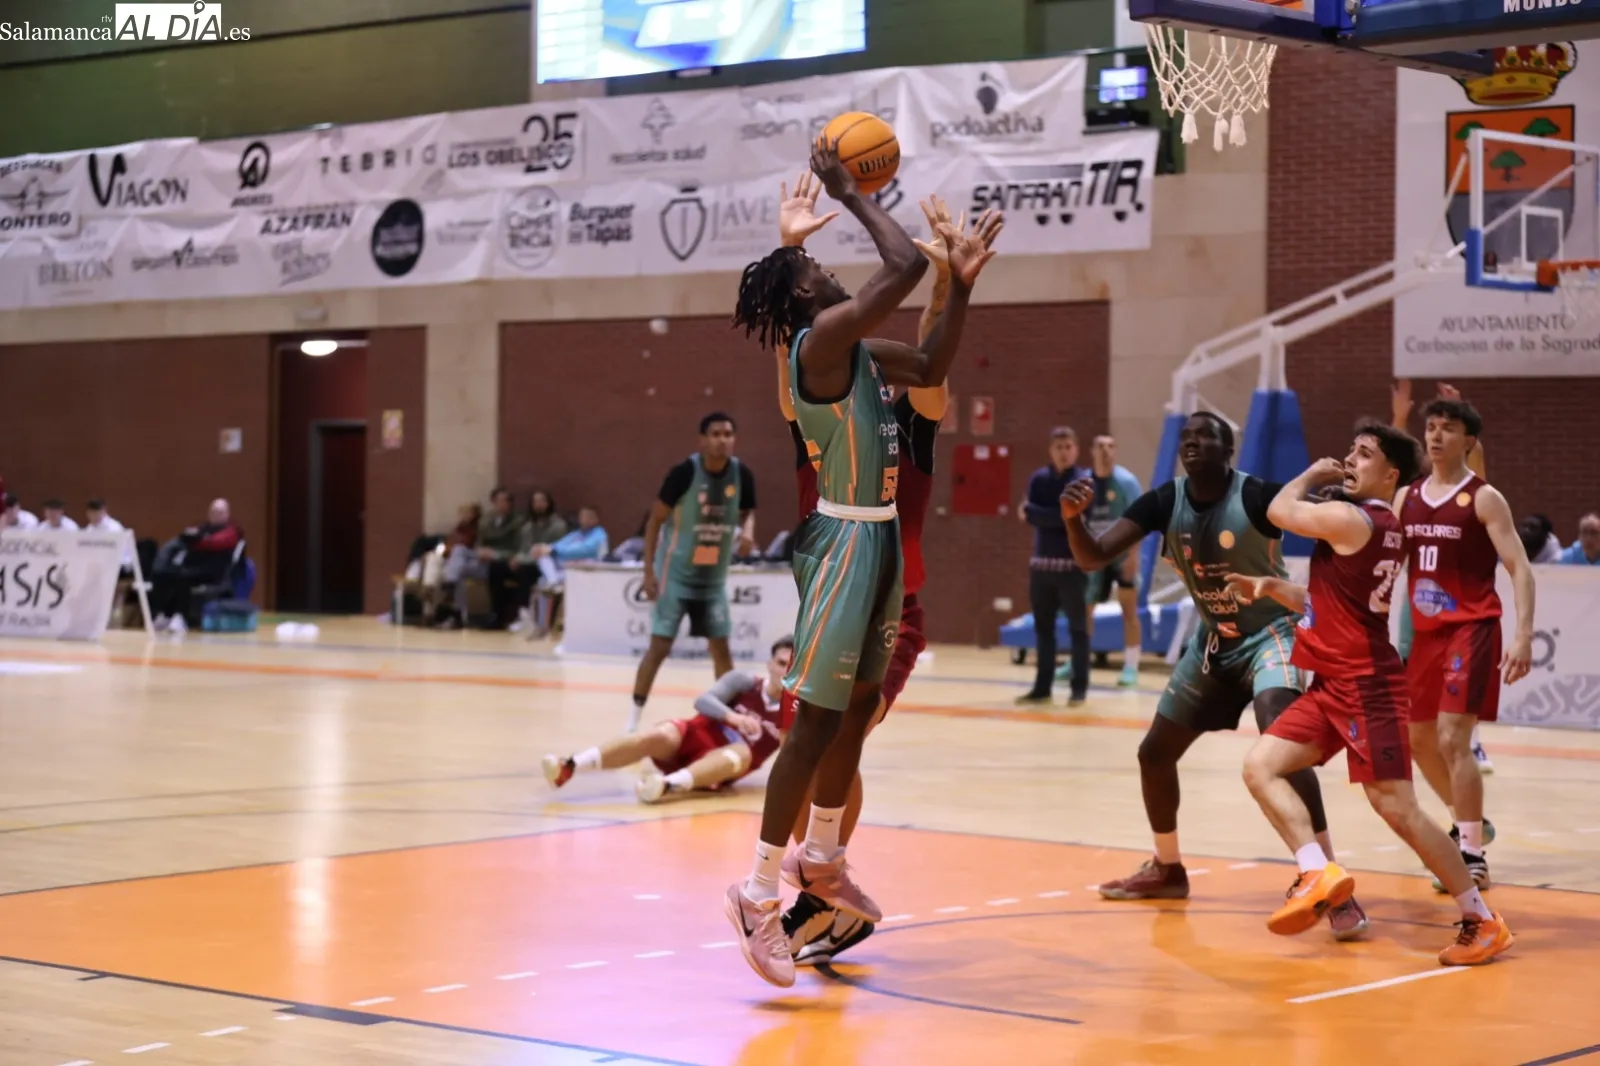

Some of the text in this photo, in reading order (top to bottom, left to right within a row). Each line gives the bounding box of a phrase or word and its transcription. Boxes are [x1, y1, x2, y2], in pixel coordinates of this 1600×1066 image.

[0, 211, 73, 232] ONTERO
[1439, 312, 1575, 334] AYUNTAMIENTO
[1494, 336, 1514, 351] de
[1521, 336, 1535, 351] la
[1542, 332, 1600, 355] Sagrad
[1418, 544, 1438, 572] 10
